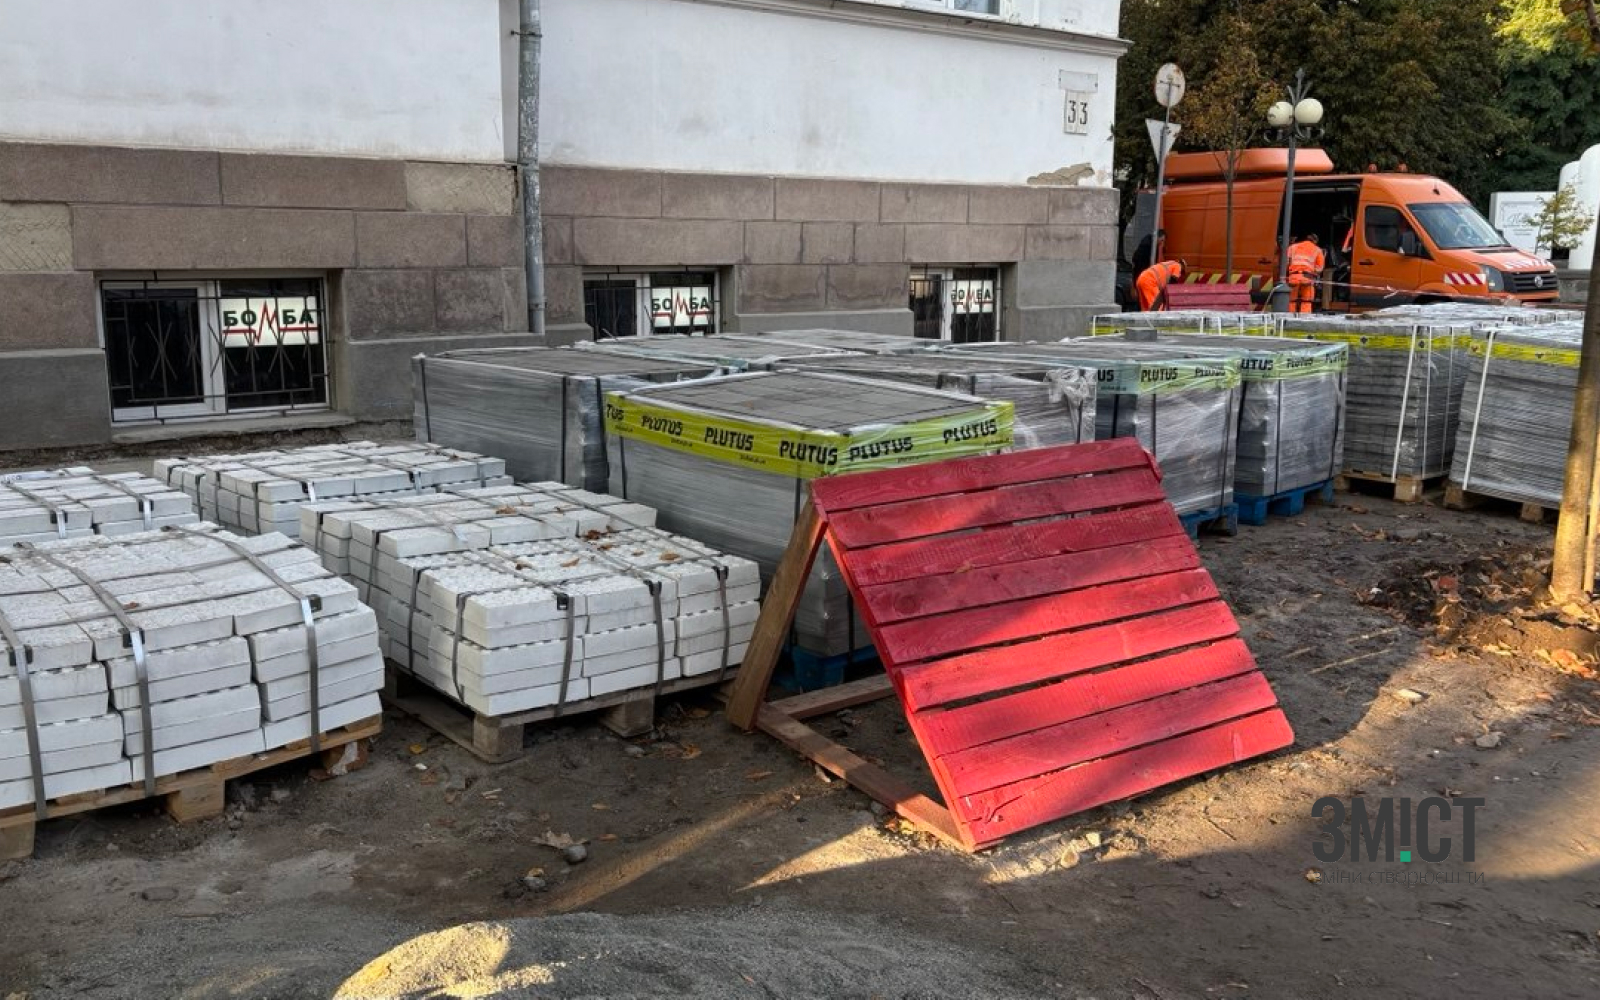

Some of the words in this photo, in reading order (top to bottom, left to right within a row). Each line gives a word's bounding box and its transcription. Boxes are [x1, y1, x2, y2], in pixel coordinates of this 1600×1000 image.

[1067, 100, 1088, 125] 33
[1140, 367, 1179, 383] PLUTUS
[641, 415, 684, 436] PLUTUS
[704, 426, 755, 452] PLUTUS
[779, 440, 839, 466] PLUTUS
[849, 436, 914, 462] PLUTUS
[942, 418, 998, 444] PLUTUS
